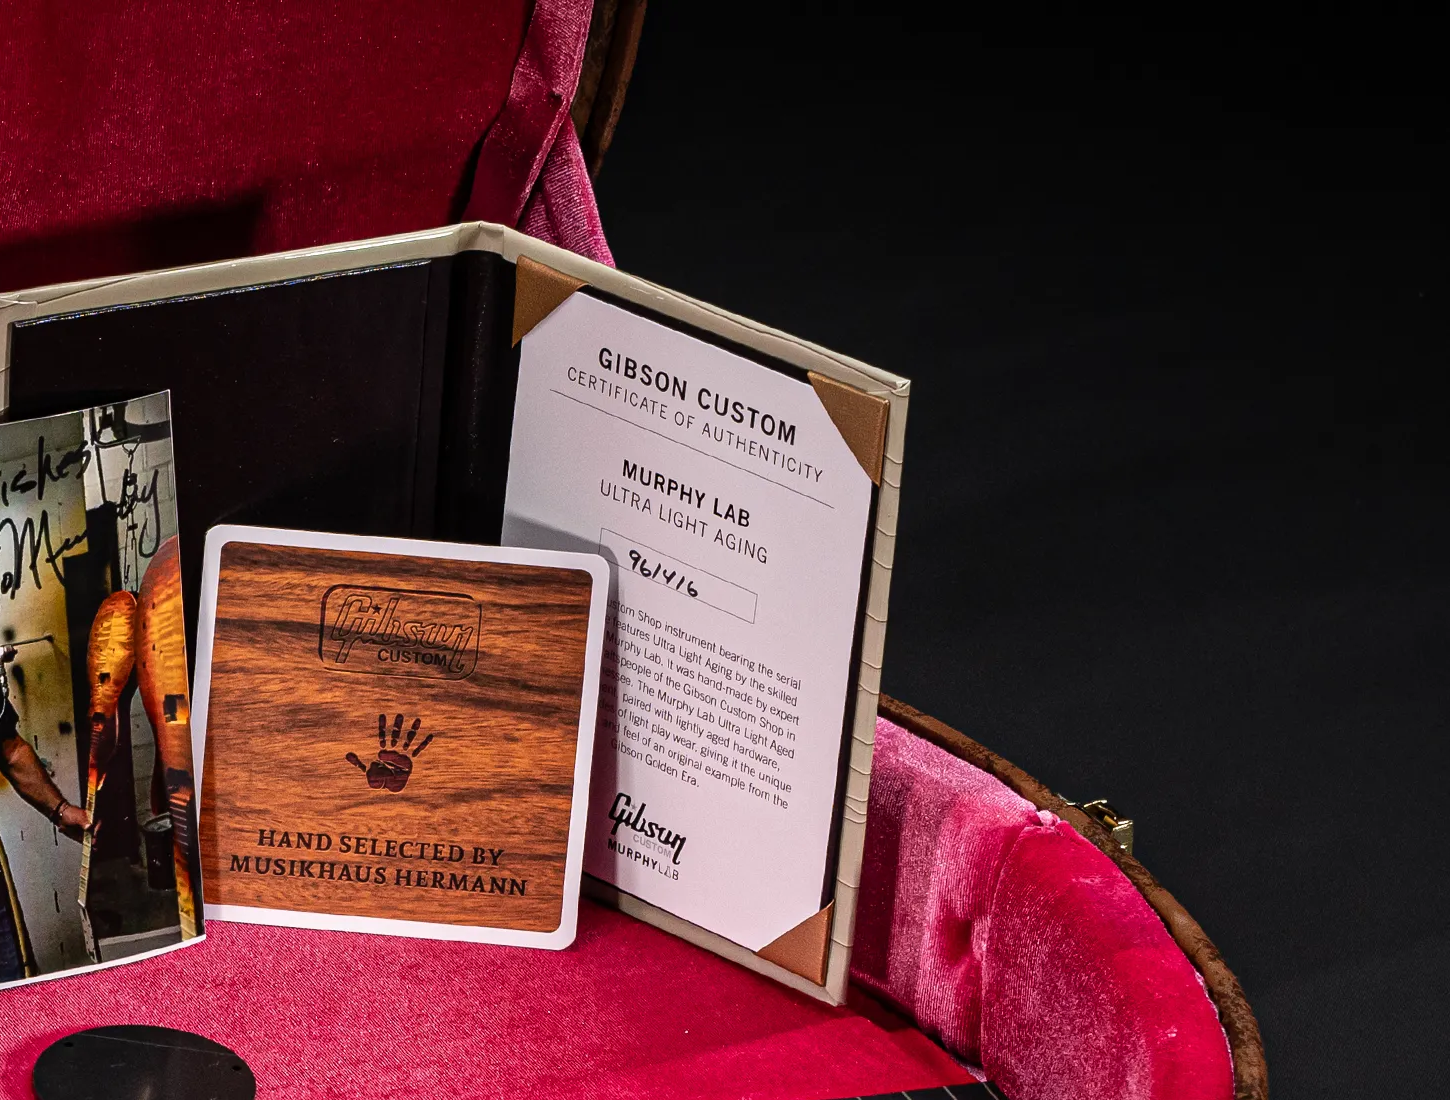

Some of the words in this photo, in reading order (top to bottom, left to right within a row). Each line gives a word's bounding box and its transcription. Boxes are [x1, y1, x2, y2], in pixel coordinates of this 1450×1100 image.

[568, 366, 667, 420] CERTIFICATE
[674, 411, 695, 429] OF
[702, 422, 823, 483] AUTHENTICITY
[599, 347, 687, 401] GIBSON
[698, 388, 796, 446] CUSTOM
[601, 479, 651, 515] ULTRA
[659, 504, 708, 538] LIGHT
[714, 529, 768, 564] AGING
[622, 459, 705, 509] MURPHY
[713, 497, 750, 527] LAB
[629, 550, 698, 598] 961416
[330, 594, 474, 674] Gibson
[378, 648, 447, 668] CUSTOM
[613, 616, 650, 642] features
[653, 634, 675, 653] Ultra
[679, 646, 701, 666] Light
[705, 657, 732, 680] Aging
[736, 670, 747, 686] by
[750, 677, 765, 692] the
[767, 686, 797, 707] skilled
[638, 610, 662, 629] Shop
[665, 622, 716, 653] instrument
[719, 645, 755, 672] bearing
[758, 663, 773, 678] the
[776, 672, 801, 690] serial
[606, 630, 641, 656] Murphy
[644, 646, 663, 666] Lab.
[676, 664, 695, 680] was
[698, 671, 753, 706] hand-made
[756, 696, 767, 712] by
[770, 706, 800, 727] expert
[666, 676, 681, 691] the
[683, 684, 717, 707] Gibson
[720, 699, 756, 724] Custom
[760, 716, 784, 738] Shop
[622, 692, 652, 712] paired
[654, 706, 673, 723] with
[676, 712, 704, 738] lightly
[706, 728, 730, 748] aged
[733, 737, 780, 771] hardware,
[629, 710, 649, 731] light
[651, 722, 671, 741] play
[700, 745, 728, 768] giving
[740, 762, 756, 777] the
[759, 771, 792, 793] unique
[638, 679, 655, 697] The
[657, 688, 695, 716] Murphy
[697, 709, 715, 724] Lab
[718, 716, 741, 735] Ultra
[744, 727, 768, 749] Light
[770, 740, 795, 760] Aged
[610, 738, 643, 762] Gibson
[646, 754, 678, 778] Golden
[681, 771, 699, 788] Era.
[623, 727, 640, 742] feel
[653, 742, 665, 754] an
[668, 748, 702, 771] original
[705, 764, 745, 790] example
[749, 782, 770, 801] from
[773, 793, 788, 809] the
[257, 828, 332, 852] HAND
[339, 835, 464, 864] SELECTED
[472, 846, 505, 867] BY
[608, 792, 686, 865] Gibson
[633, 834, 671, 858] CUSTOM
[230, 854, 387, 886] MUSIKHAUS
[395, 867, 528, 897] HERMANN
